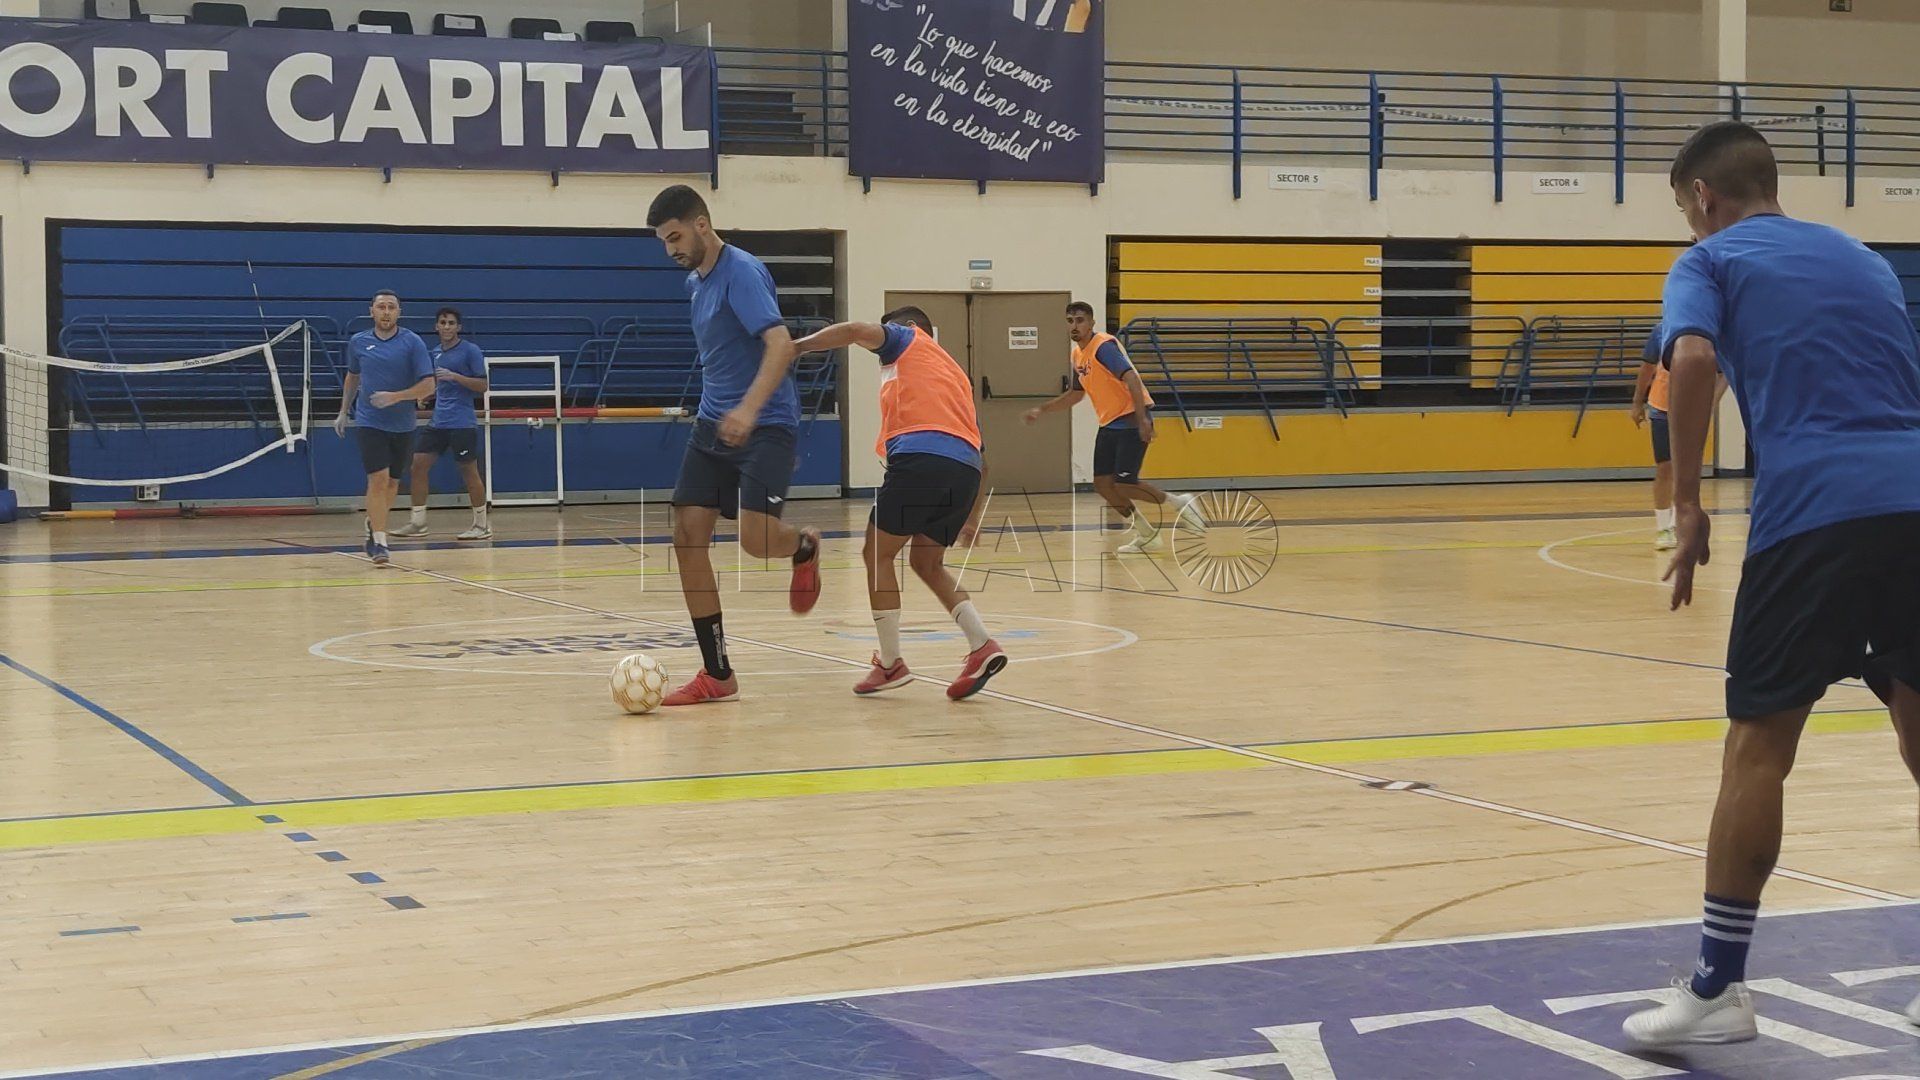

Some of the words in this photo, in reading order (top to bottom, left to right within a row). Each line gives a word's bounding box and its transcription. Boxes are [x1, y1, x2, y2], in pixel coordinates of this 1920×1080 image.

[941, 36, 979, 67] que
[981, 40, 1053, 94] hacemos
[0, 42, 228, 138] ORT
[266, 52, 709, 150] CAPITAL
[870, 43, 899, 67] en
[903, 43, 928, 77] la
[930, 66, 969, 96] vida
[973, 80, 1020, 117] tiene
[1022, 108, 1042, 129] su
[1045, 119, 1082, 142] eco
[894, 91, 921, 117] en
[925, 93, 949, 127] la
[1276, 173, 1310, 183] SECTOR
[1539, 178, 1570, 187] SECTOR
[1573, 178, 1579, 187] 6
[1884, 187, 1913, 196] SECTOR
